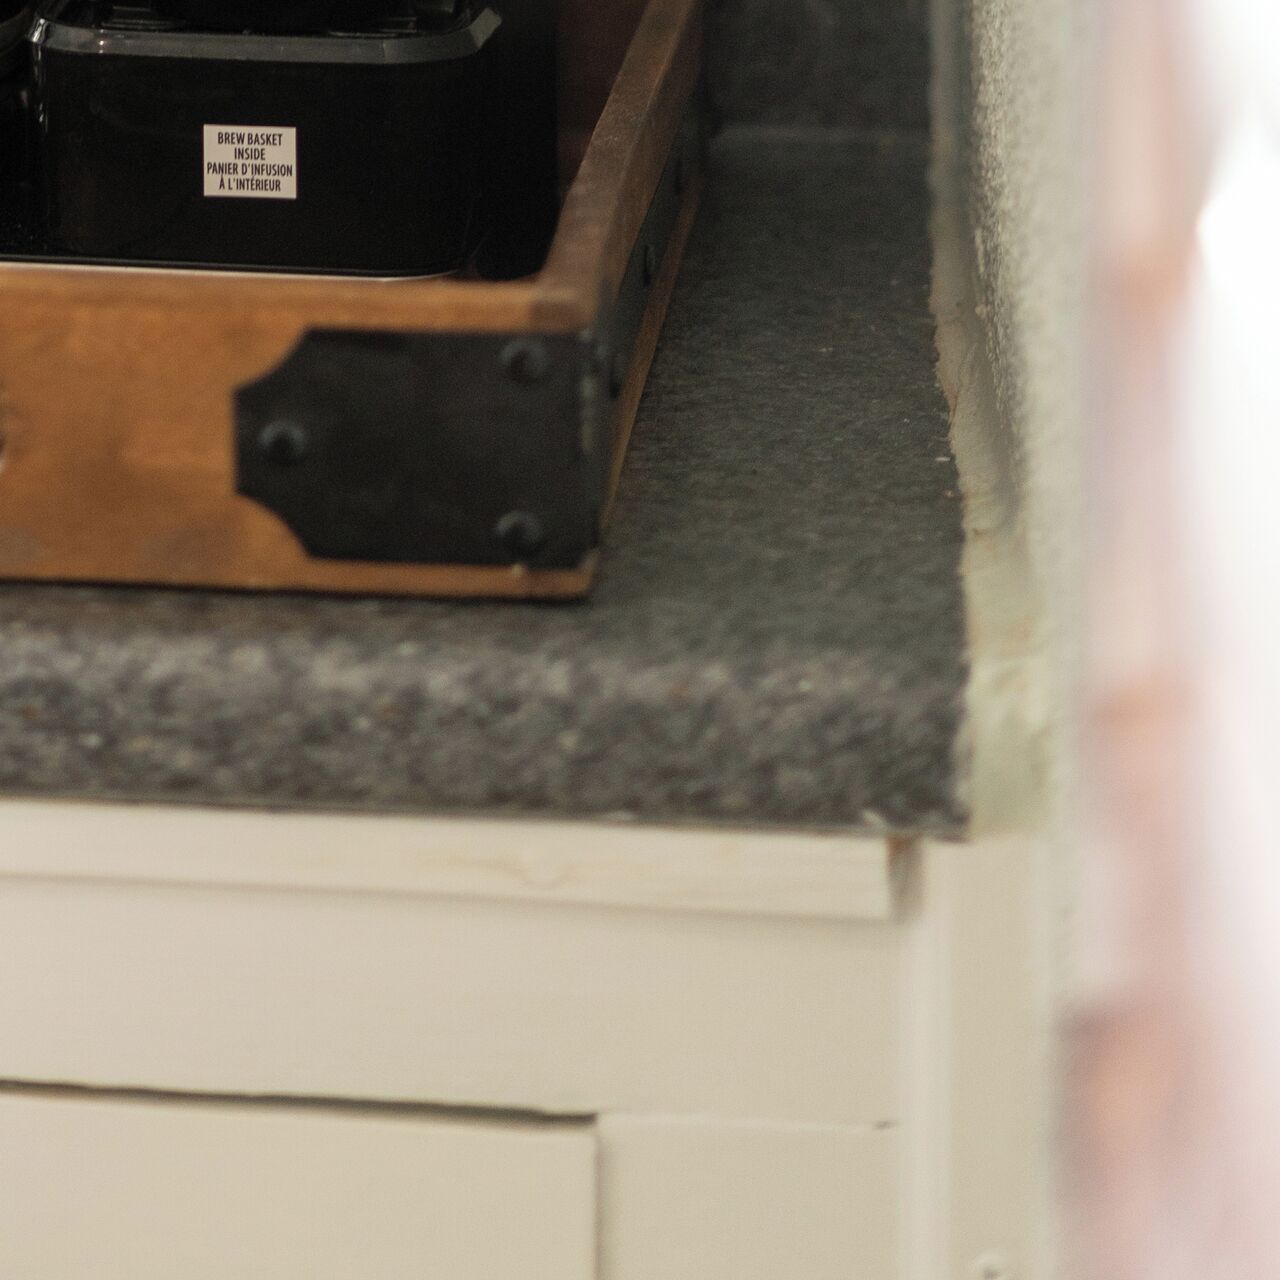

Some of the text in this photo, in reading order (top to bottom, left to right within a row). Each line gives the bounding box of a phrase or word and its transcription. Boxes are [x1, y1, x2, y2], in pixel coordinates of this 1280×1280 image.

[217, 132, 283, 146] BREW BASKET
[234, 147, 266, 160] INSIDE
[207, 162, 293, 177] PANIER D'INFUSION
[219, 174, 281, 192] À L'INTÉRIEUR
